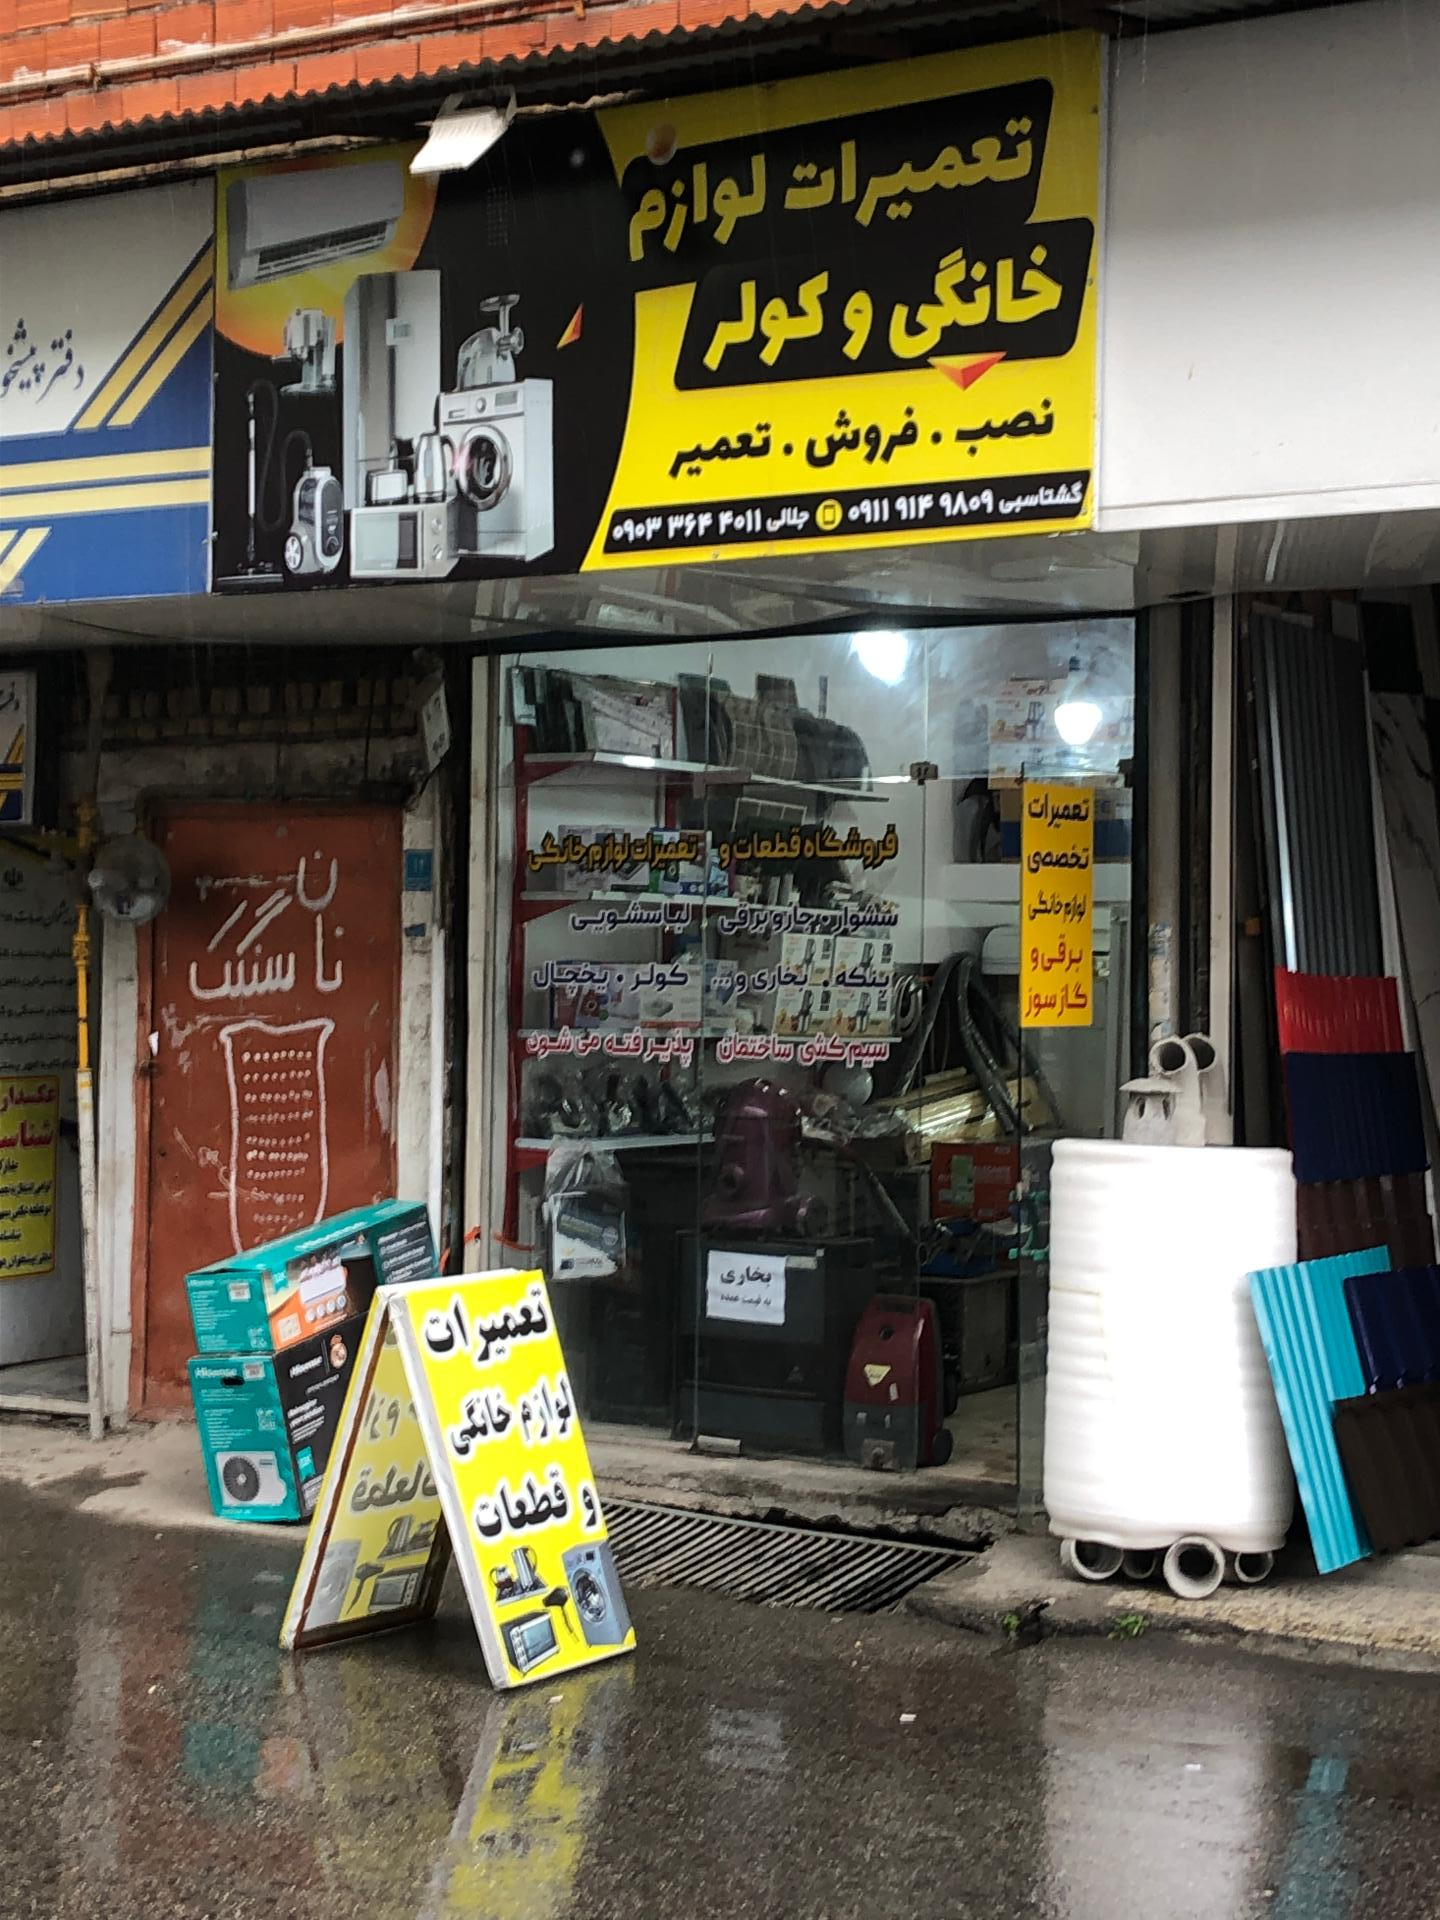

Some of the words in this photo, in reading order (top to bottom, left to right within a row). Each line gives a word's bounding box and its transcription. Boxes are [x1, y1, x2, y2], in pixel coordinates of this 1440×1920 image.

[784, 115, 1033, 227] تعمیرات
[629, 154, 765, 262] لوازم
[889, 243, 1063, 359] خانگی
[703, 272, 829, 372] کولر
[843, 290, 873, 360] و
[0, 318, 46, 398] پیشخو
[36, 329, 84, 404] دفتر
[805, 407, 919, 468] فروش
[955, 398, 1054, 457] نصب
[669, 422, 771, 478] تعمیر
[848, 498, 889, 524] ۰۹۱۱
[895, 494, 934, 521] ۹۱۴
[939, 488, 994, 517] ۹۸۰۹
[999, 480, 1083, 515] گشتاسبی
[612, 515, 662, 543] ۰۹۰۳
[667, 512, 713, 539] ۳۶۴
[718, 507, 761, 535] ۴۰۱۱
[766, 506, 810, 532] جلالی
[1028, 793, 1089, 828] تعمیرات
[528, 830, 588, 872] خانگی
[587, 832, 631, 872] لوازم
[631, 833, 698, 868] تعمیرات
[719, 842, 731, 870] و
[734, 825, 801, 859] قطعات
[803, 823, 899, 870] فروشگاه
[1027, 845, 1089, 873] تخصصی
[571, 901, 691, 932] لباسشویی
[834, 904, 898, 936] سشوار
[1027, 889, 1062, 922] خانگی
[1062, 894, 1087, 924] لوازم
[1030, 946, 1038, 972] و
[1041, 934, 1083, 972] برقی
[533, 961, 608, 996] یخچال
[630, 963, 689, 992] کولر
[752, 964, 808, 992] بخاری
[836, 966, 890, 998] پنکه
[575, 1033, 601, 1056] می
[717, 1033, 794, 1063] ساختمان
[720, 1265, 772, 1288] بخاری
[425, 1288, 547, 1362] تعمیرات
[451, 1393, 511, 1455] خانگی
[521, 1378, 572, 1441] لوازم
[476, 1469, 568, 1537] قطعات
[582, 1485, 597, 1527] و
